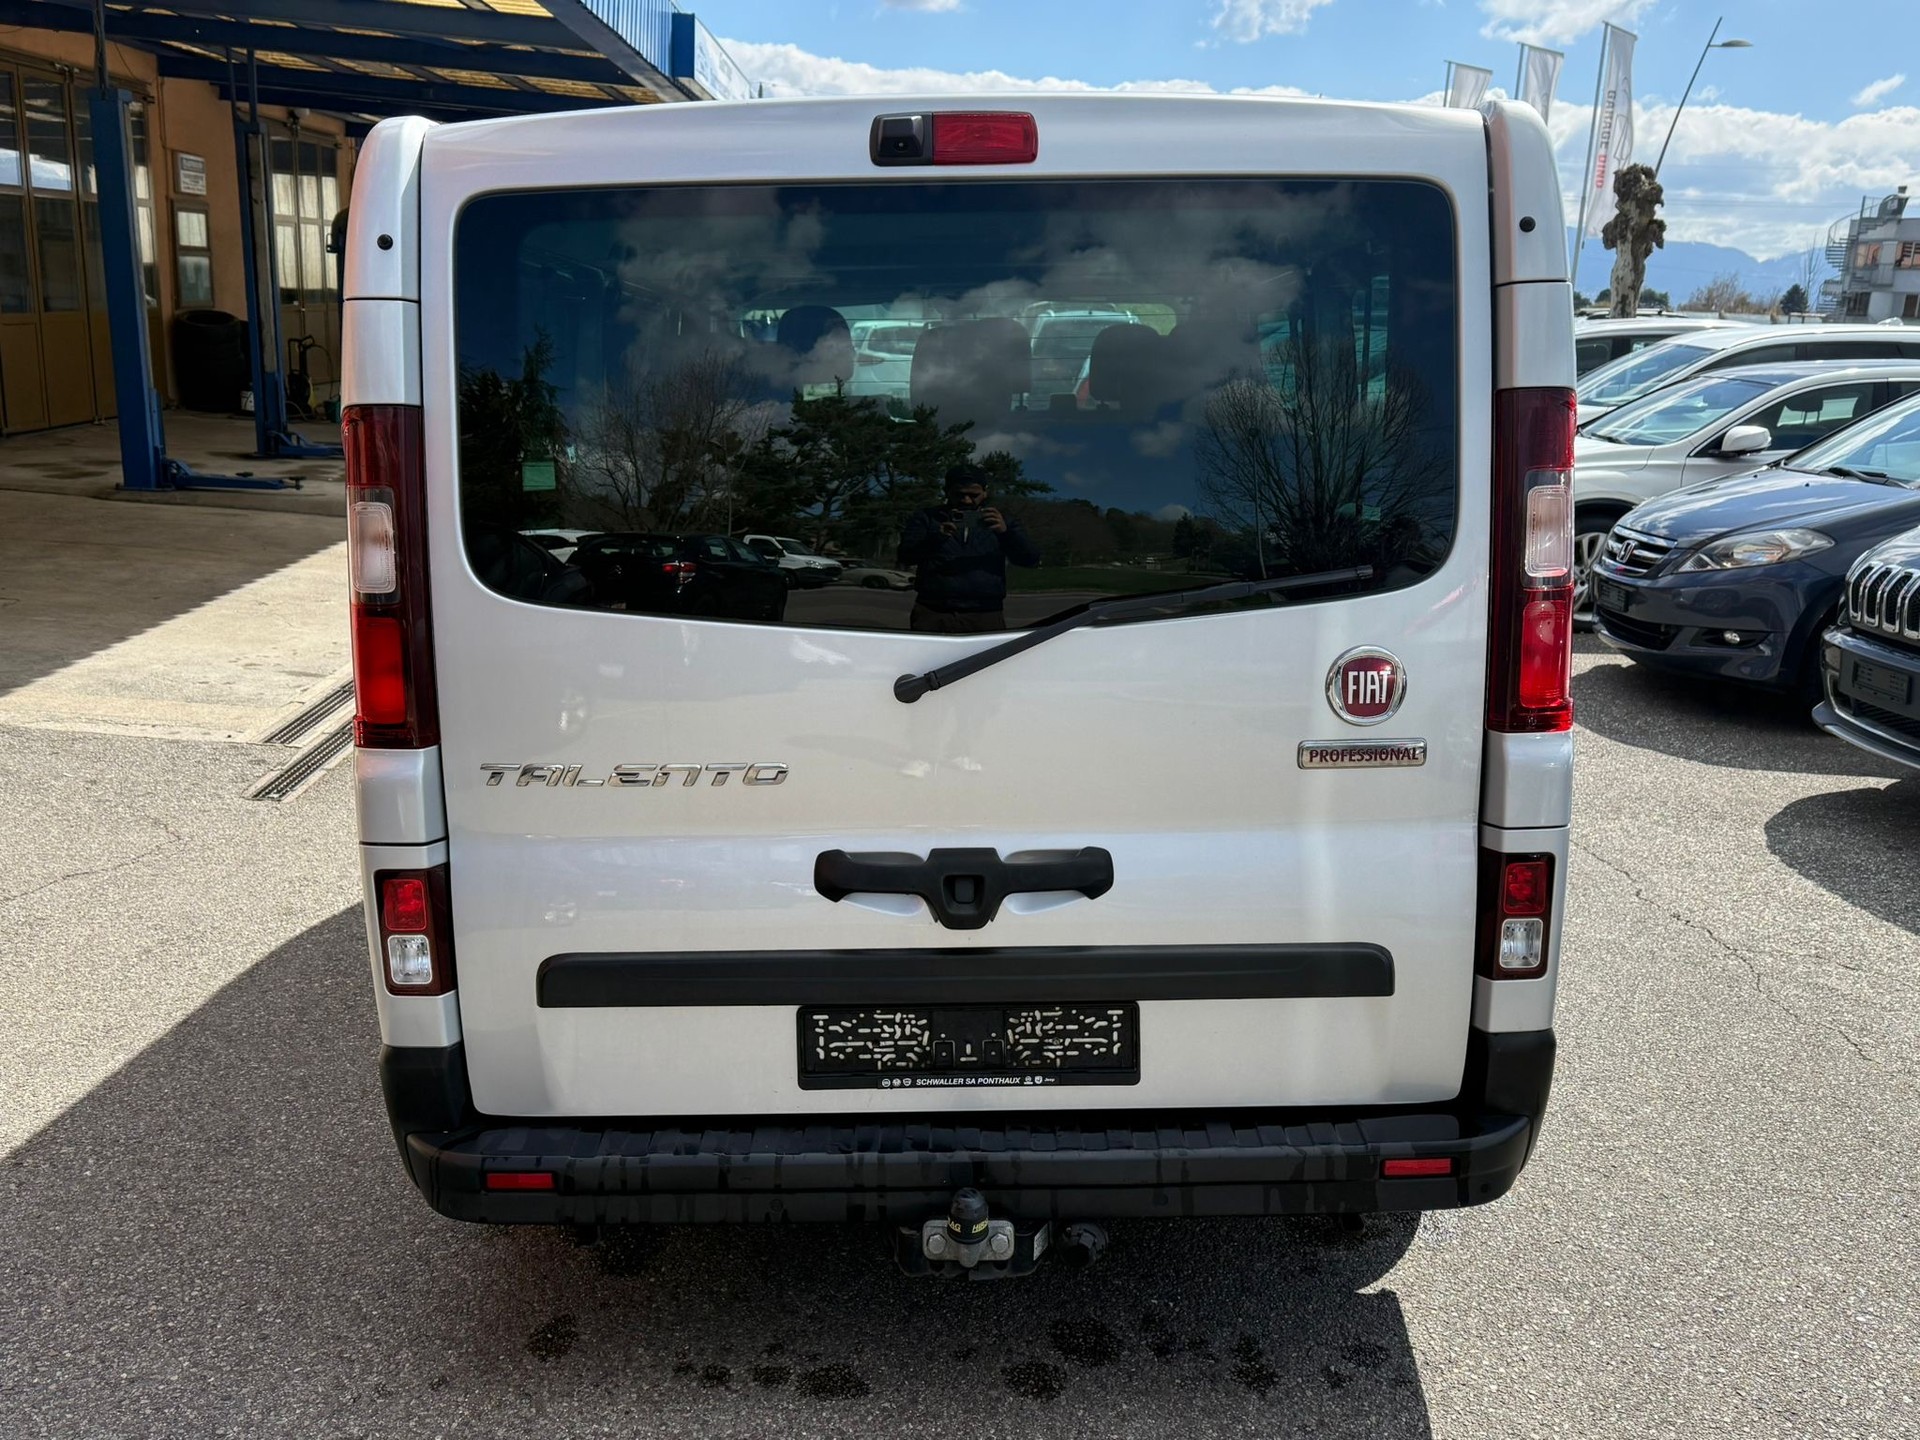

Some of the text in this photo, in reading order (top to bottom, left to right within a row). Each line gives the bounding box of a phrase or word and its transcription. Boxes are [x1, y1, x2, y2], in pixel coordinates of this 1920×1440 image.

[1600, 89, 1616, 149] GARAGE
[1347, 670, 1392, 705] FIAT
[1309, 747, 1420, 763] PROFESSIONAL
[479, 762, 789, 787] TALENTO
[915, 1077, 964, 1087] SCHWALLER
[965, 1077, 975, 1086] SA
[977, 1076, 1021, 1086] PONTHAUX
